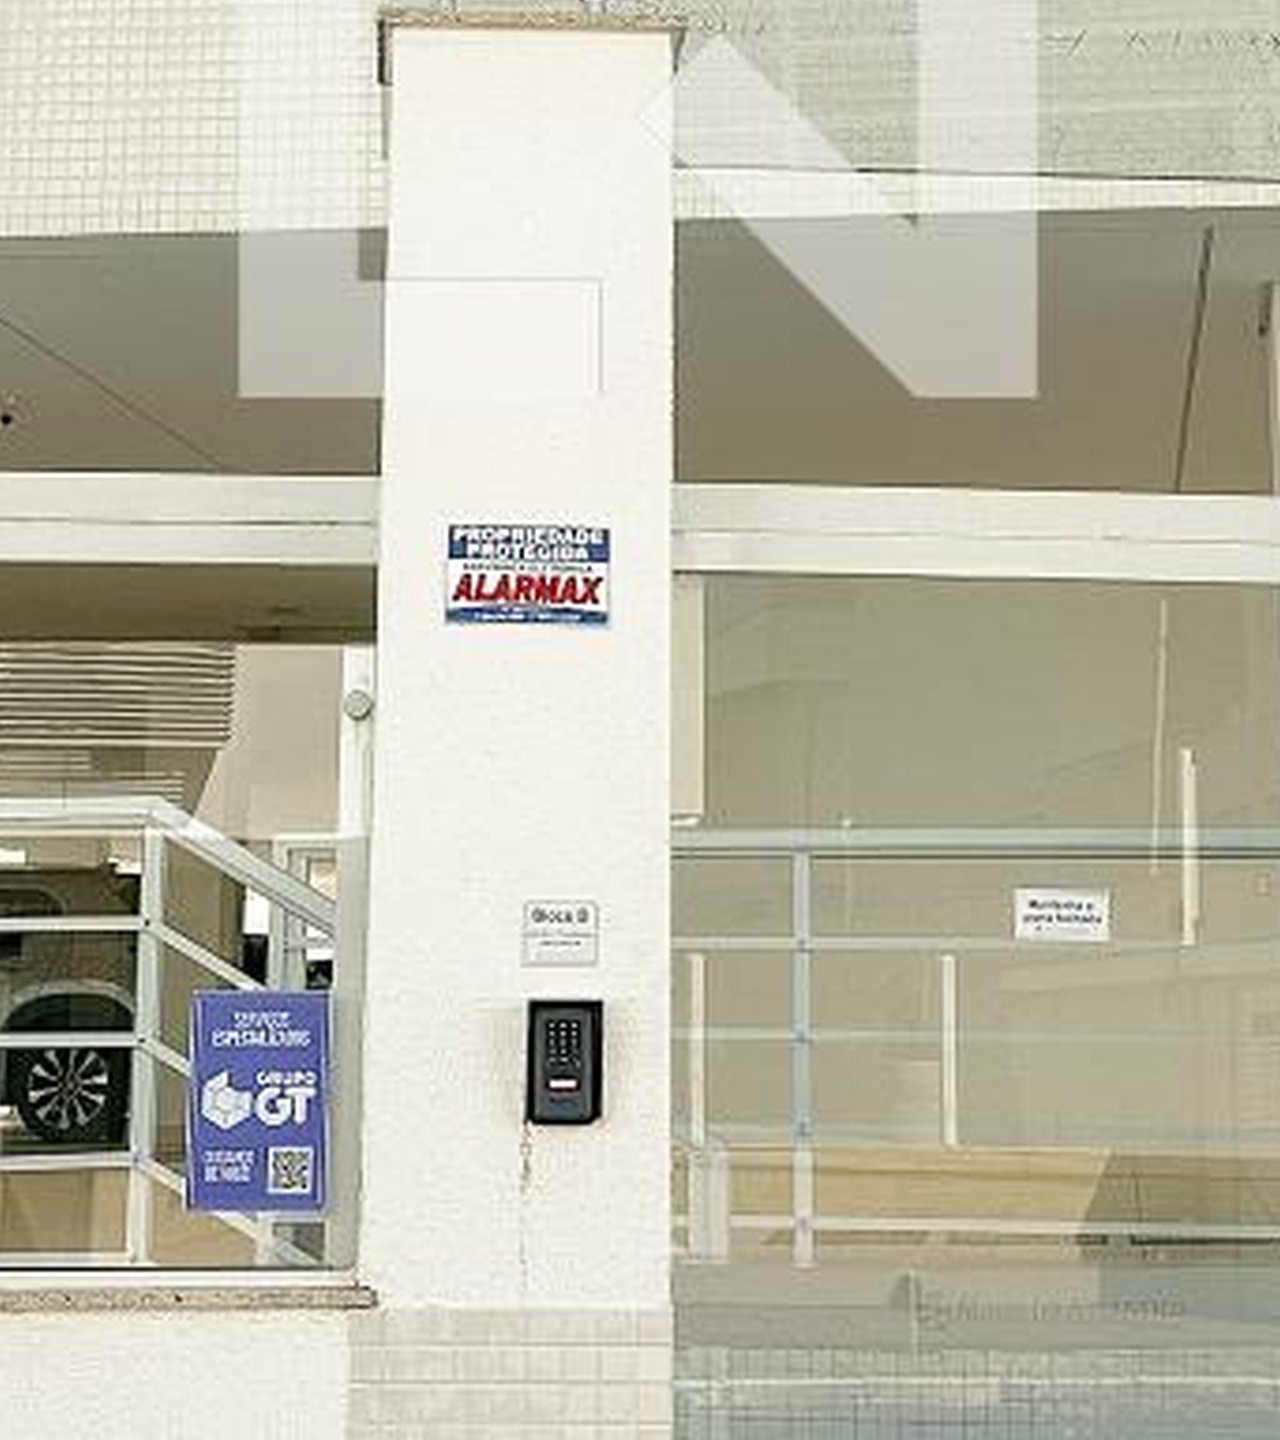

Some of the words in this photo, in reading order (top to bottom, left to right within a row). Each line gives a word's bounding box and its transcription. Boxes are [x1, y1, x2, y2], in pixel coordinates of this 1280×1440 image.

[453, 527, 604, 545] PROPRIEDADE
[467, 544, 591, 560] PROTEGIDA
[452, 573, 603, 604] ALARMAX
[255, 1087, 317, 1127] GT
